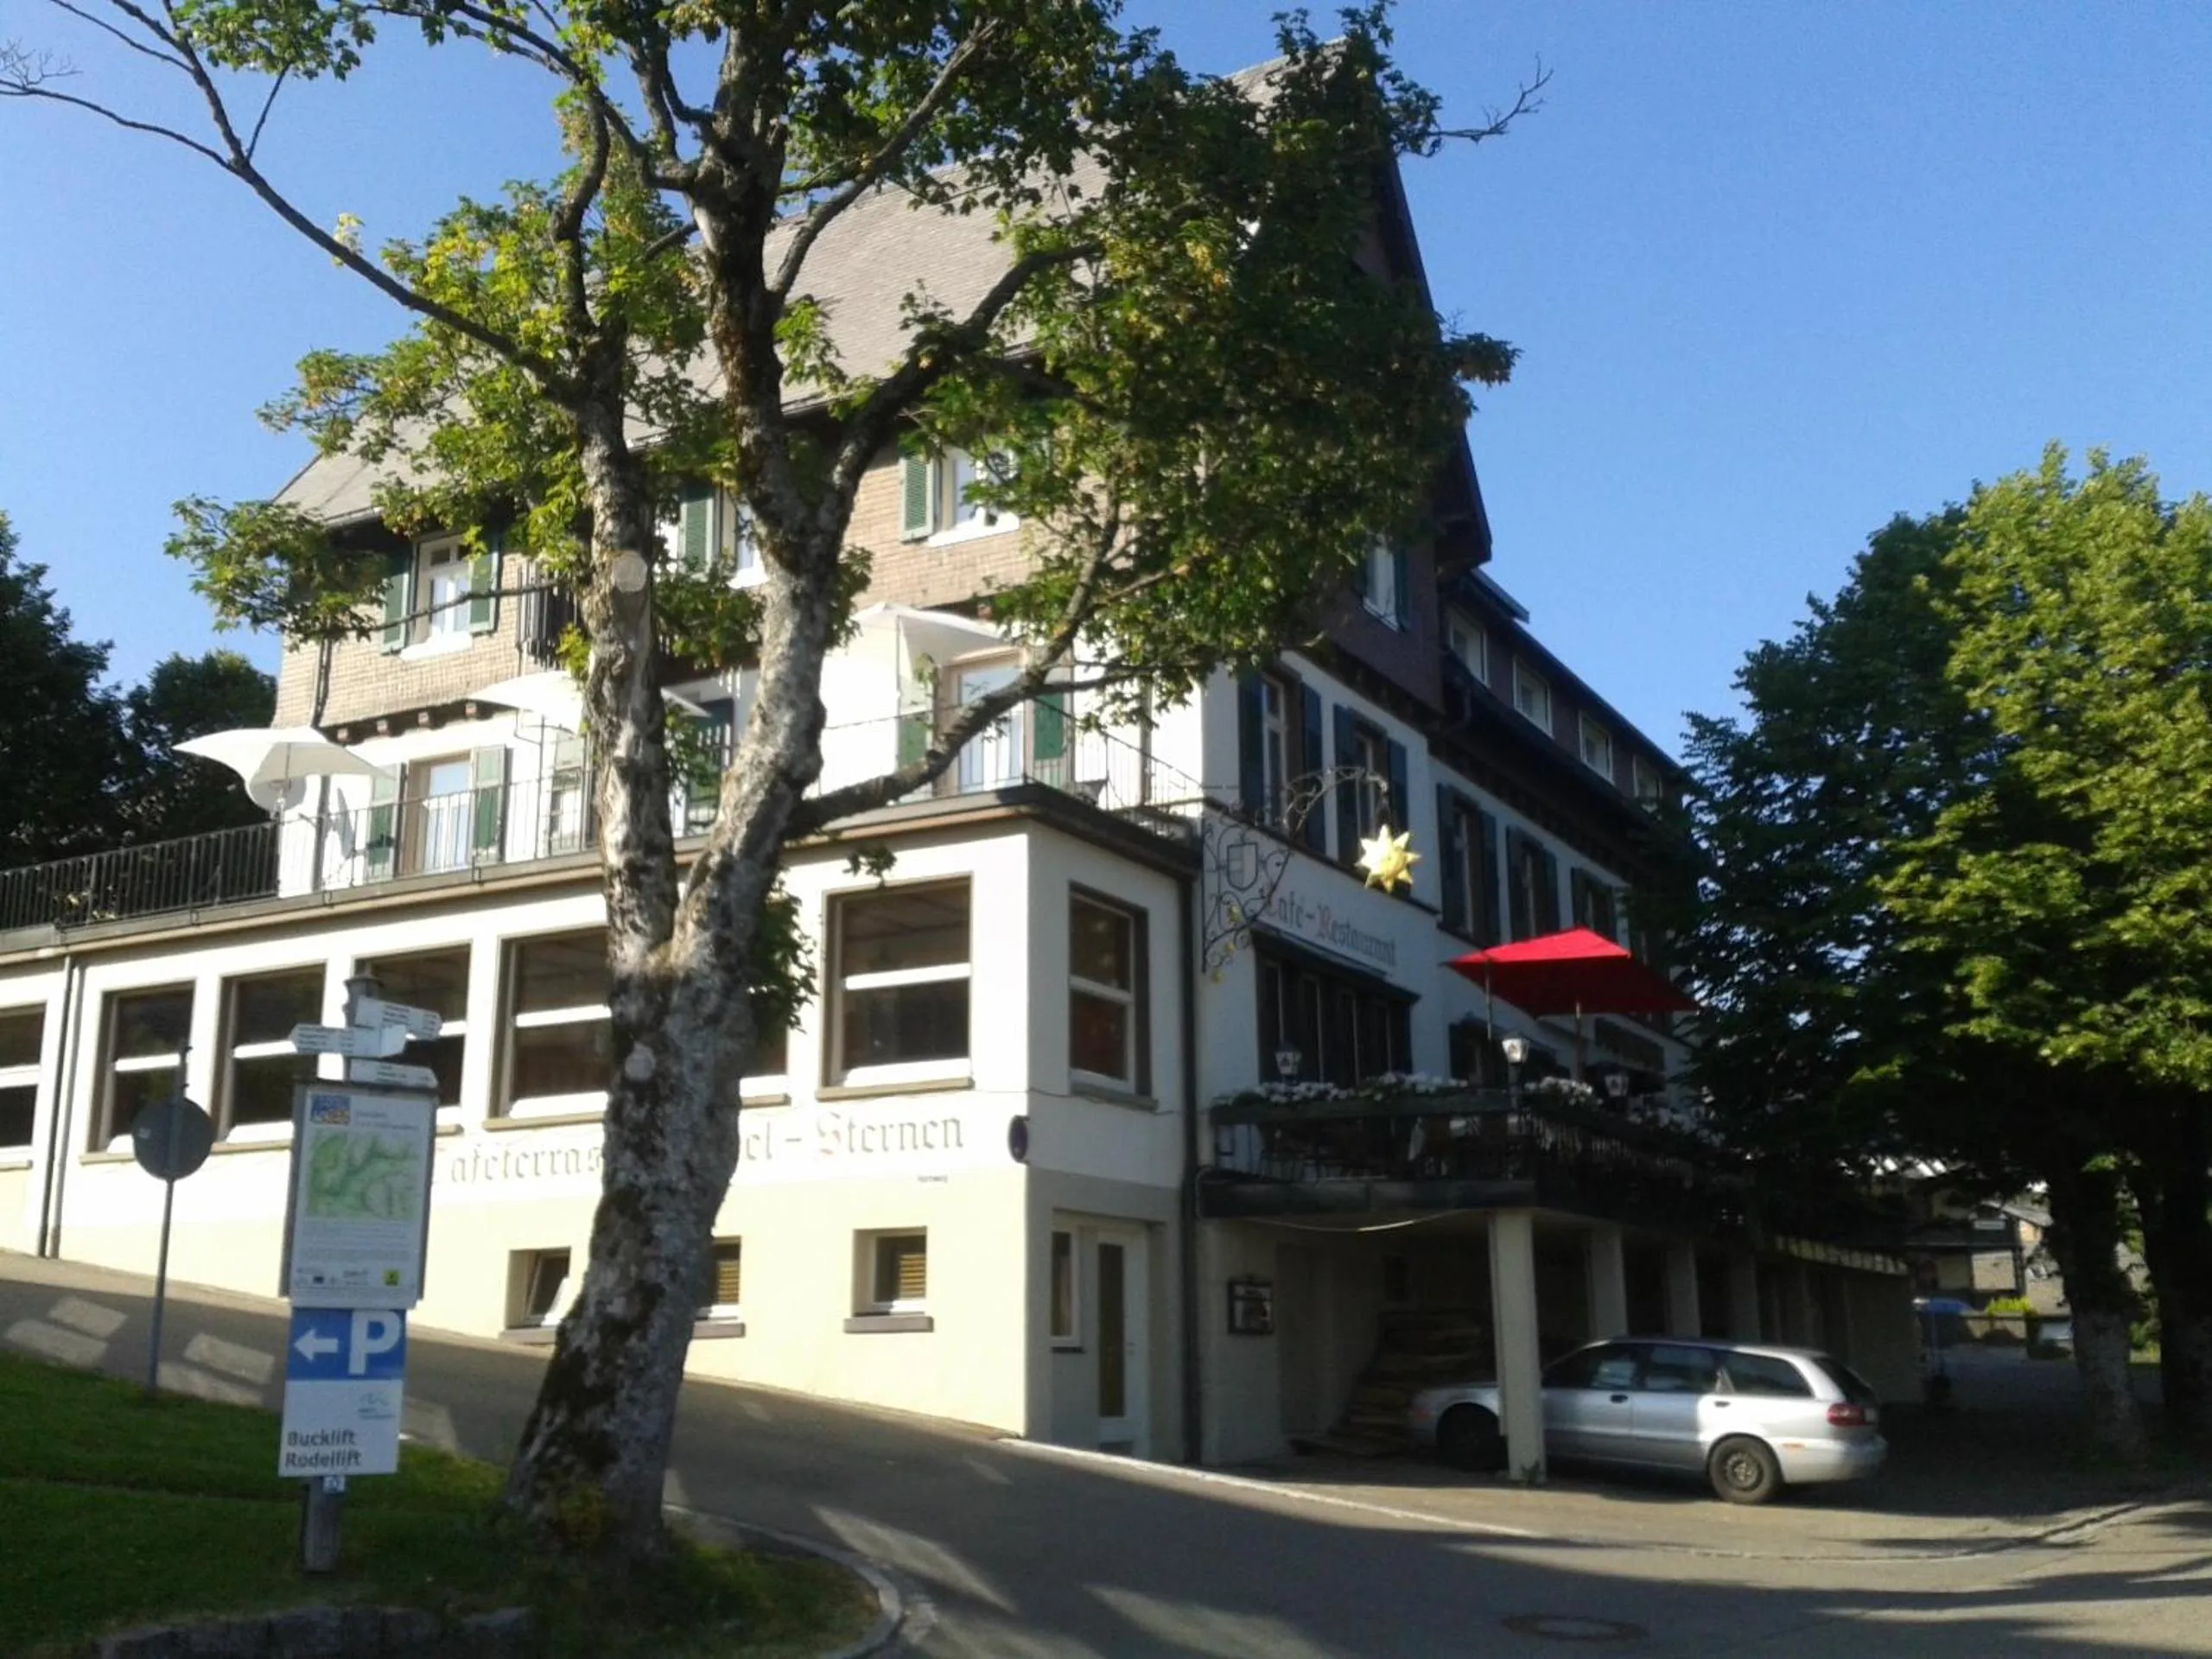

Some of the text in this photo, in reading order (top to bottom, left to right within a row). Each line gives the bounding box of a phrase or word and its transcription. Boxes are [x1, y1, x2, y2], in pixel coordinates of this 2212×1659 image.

[348, 1309, 401, 1376] P
[286, 1427, 356, 1446] Bucklift
[284, 1447, 362, 1470] Rodellift
